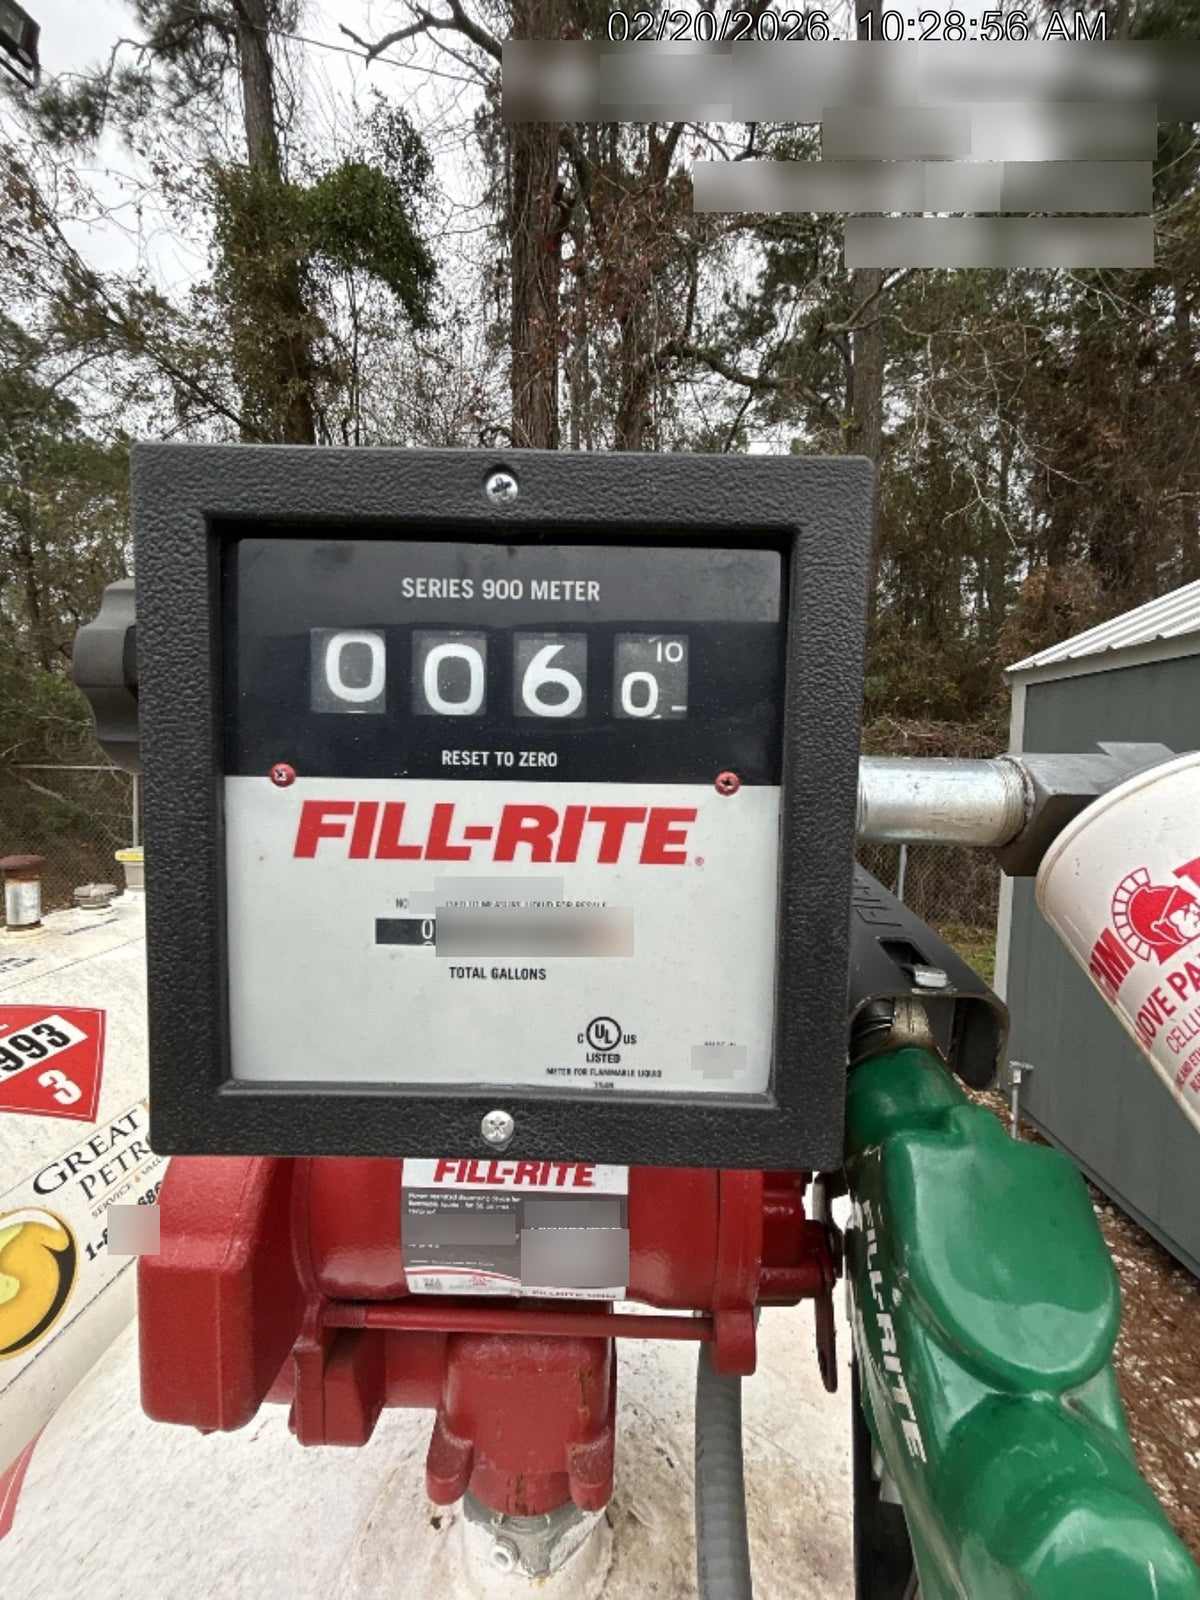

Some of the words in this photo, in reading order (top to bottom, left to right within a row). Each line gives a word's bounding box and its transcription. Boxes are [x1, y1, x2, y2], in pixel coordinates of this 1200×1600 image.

[401, 577, 474, 599] SERIES
[482, 579, 524, 600] 900
[531, 580, 600, 602] METER
[441, 750, 490, 766] RESET
[494, 751, 515, 767] TO
[519, 751, 558, 768] ZERO
[293, 800, 698, 865] FILL-RITE
[449, 966, 487, 980] TOTAL
[491, 967, 547, 981] GALLONS
[0, 1024, 72, 1072] 993
[623, 1034, 637, 1045] US
[586, 1053, 621, 1064] LISTED
[546, 1067, 571, 1076] METER
[574, 1068, 588, 1077] FOR
[37, 1069, 83, 1106] 3
[33, 1109, 140, 1195] GREAT
[77, 1133, 152, 1201] PETR
[433, 1159, 597, 1187] FILL-RITE
